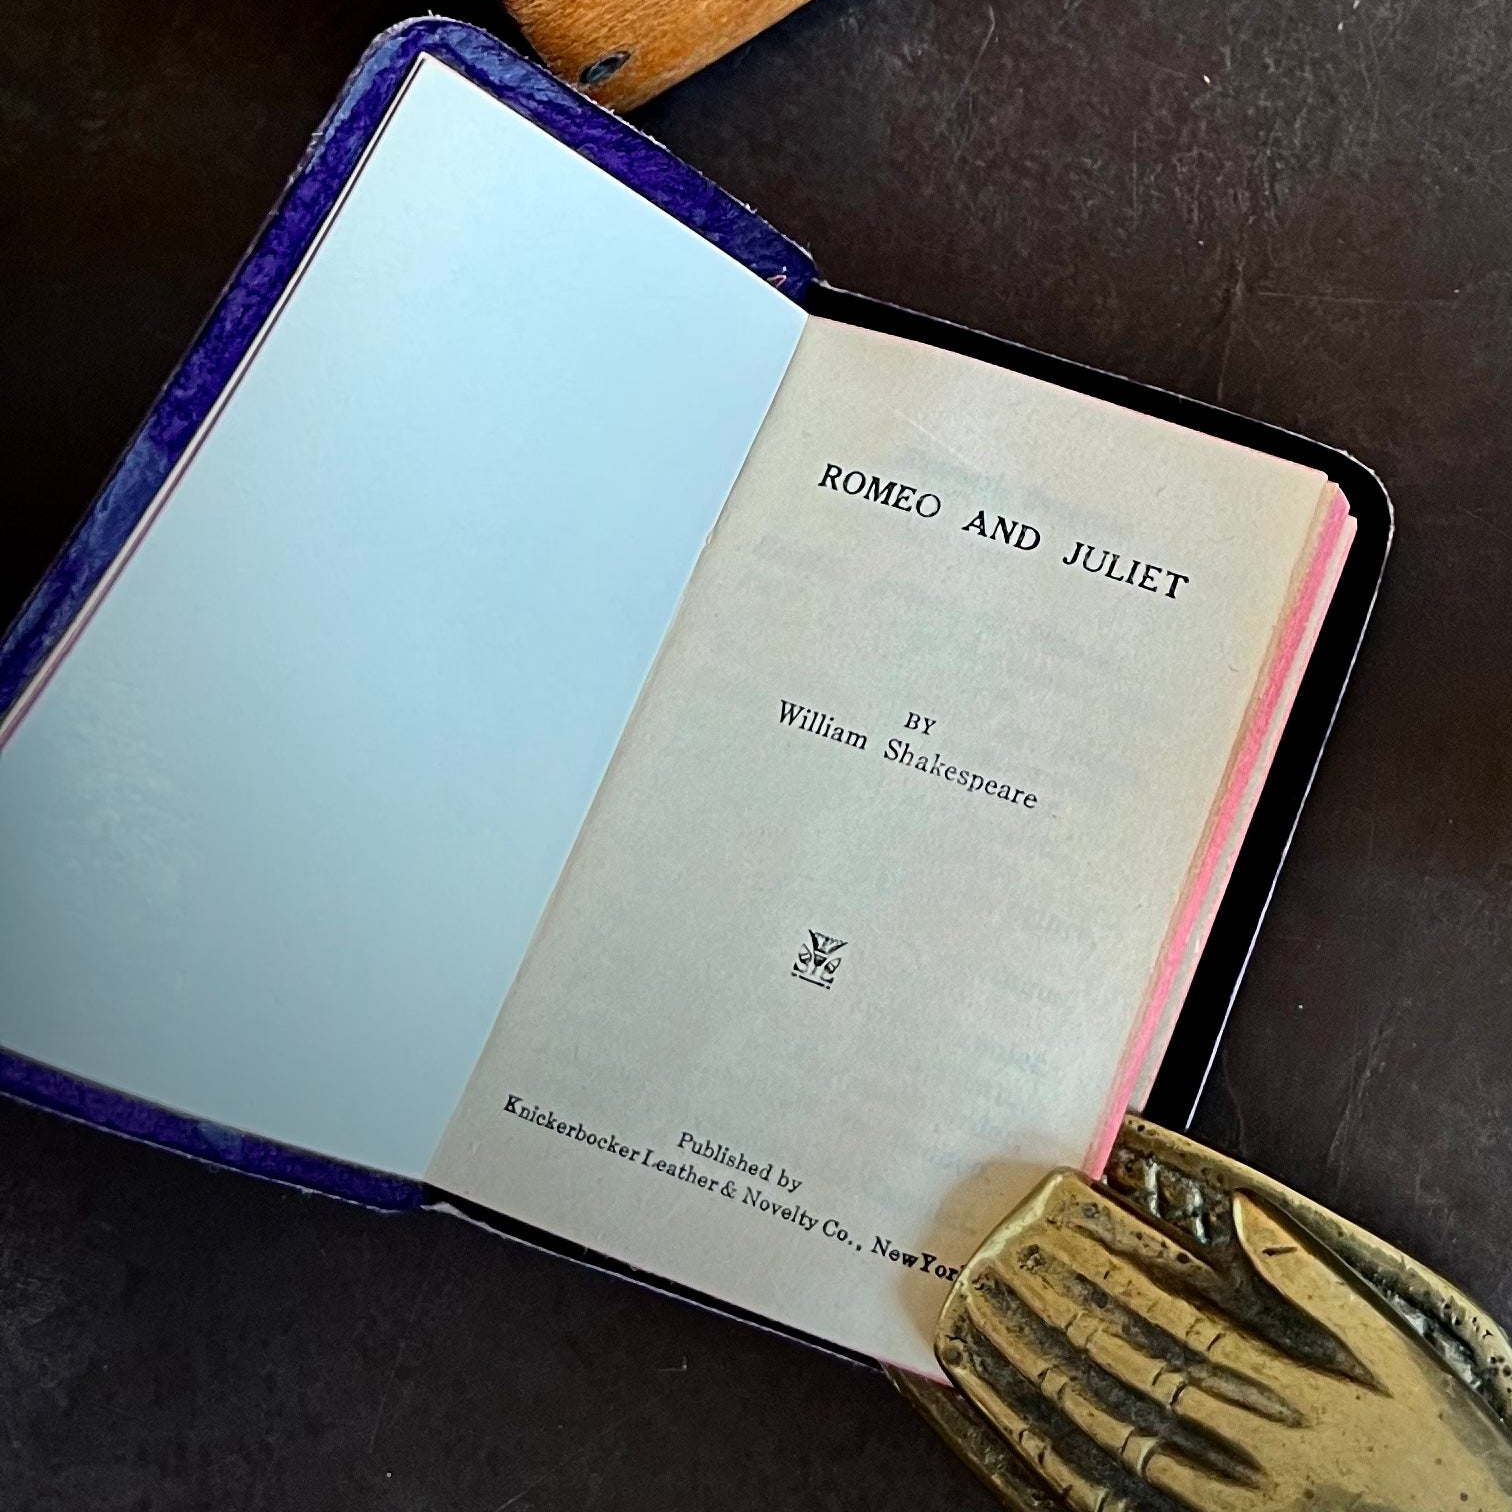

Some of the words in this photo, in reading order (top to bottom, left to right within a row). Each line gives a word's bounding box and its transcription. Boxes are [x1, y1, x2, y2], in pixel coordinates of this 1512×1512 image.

[817, 463, 941, 518] ROMEO
[961, 510, 1041, 551] AND
[1062, 541, 1190, 599] JULIET
[779, 699, 867, 750] William
[883, 738, 1038, 809] Shakespeare
[904, 711, 936, 735] BY
[504, 1094, 640, 1162] Knickerbocker
[641, 1147, 719, 1192] Leather
[720, 1180, 737, 1199] &
[742, 1186, 818, 1231] Novelty
[871, 1235, 918, 1269] New
[920, 1252, 967, 1281] Yor
[677, 1132, 772, 1182] Published
[777, 1168, 803, 1193] by
